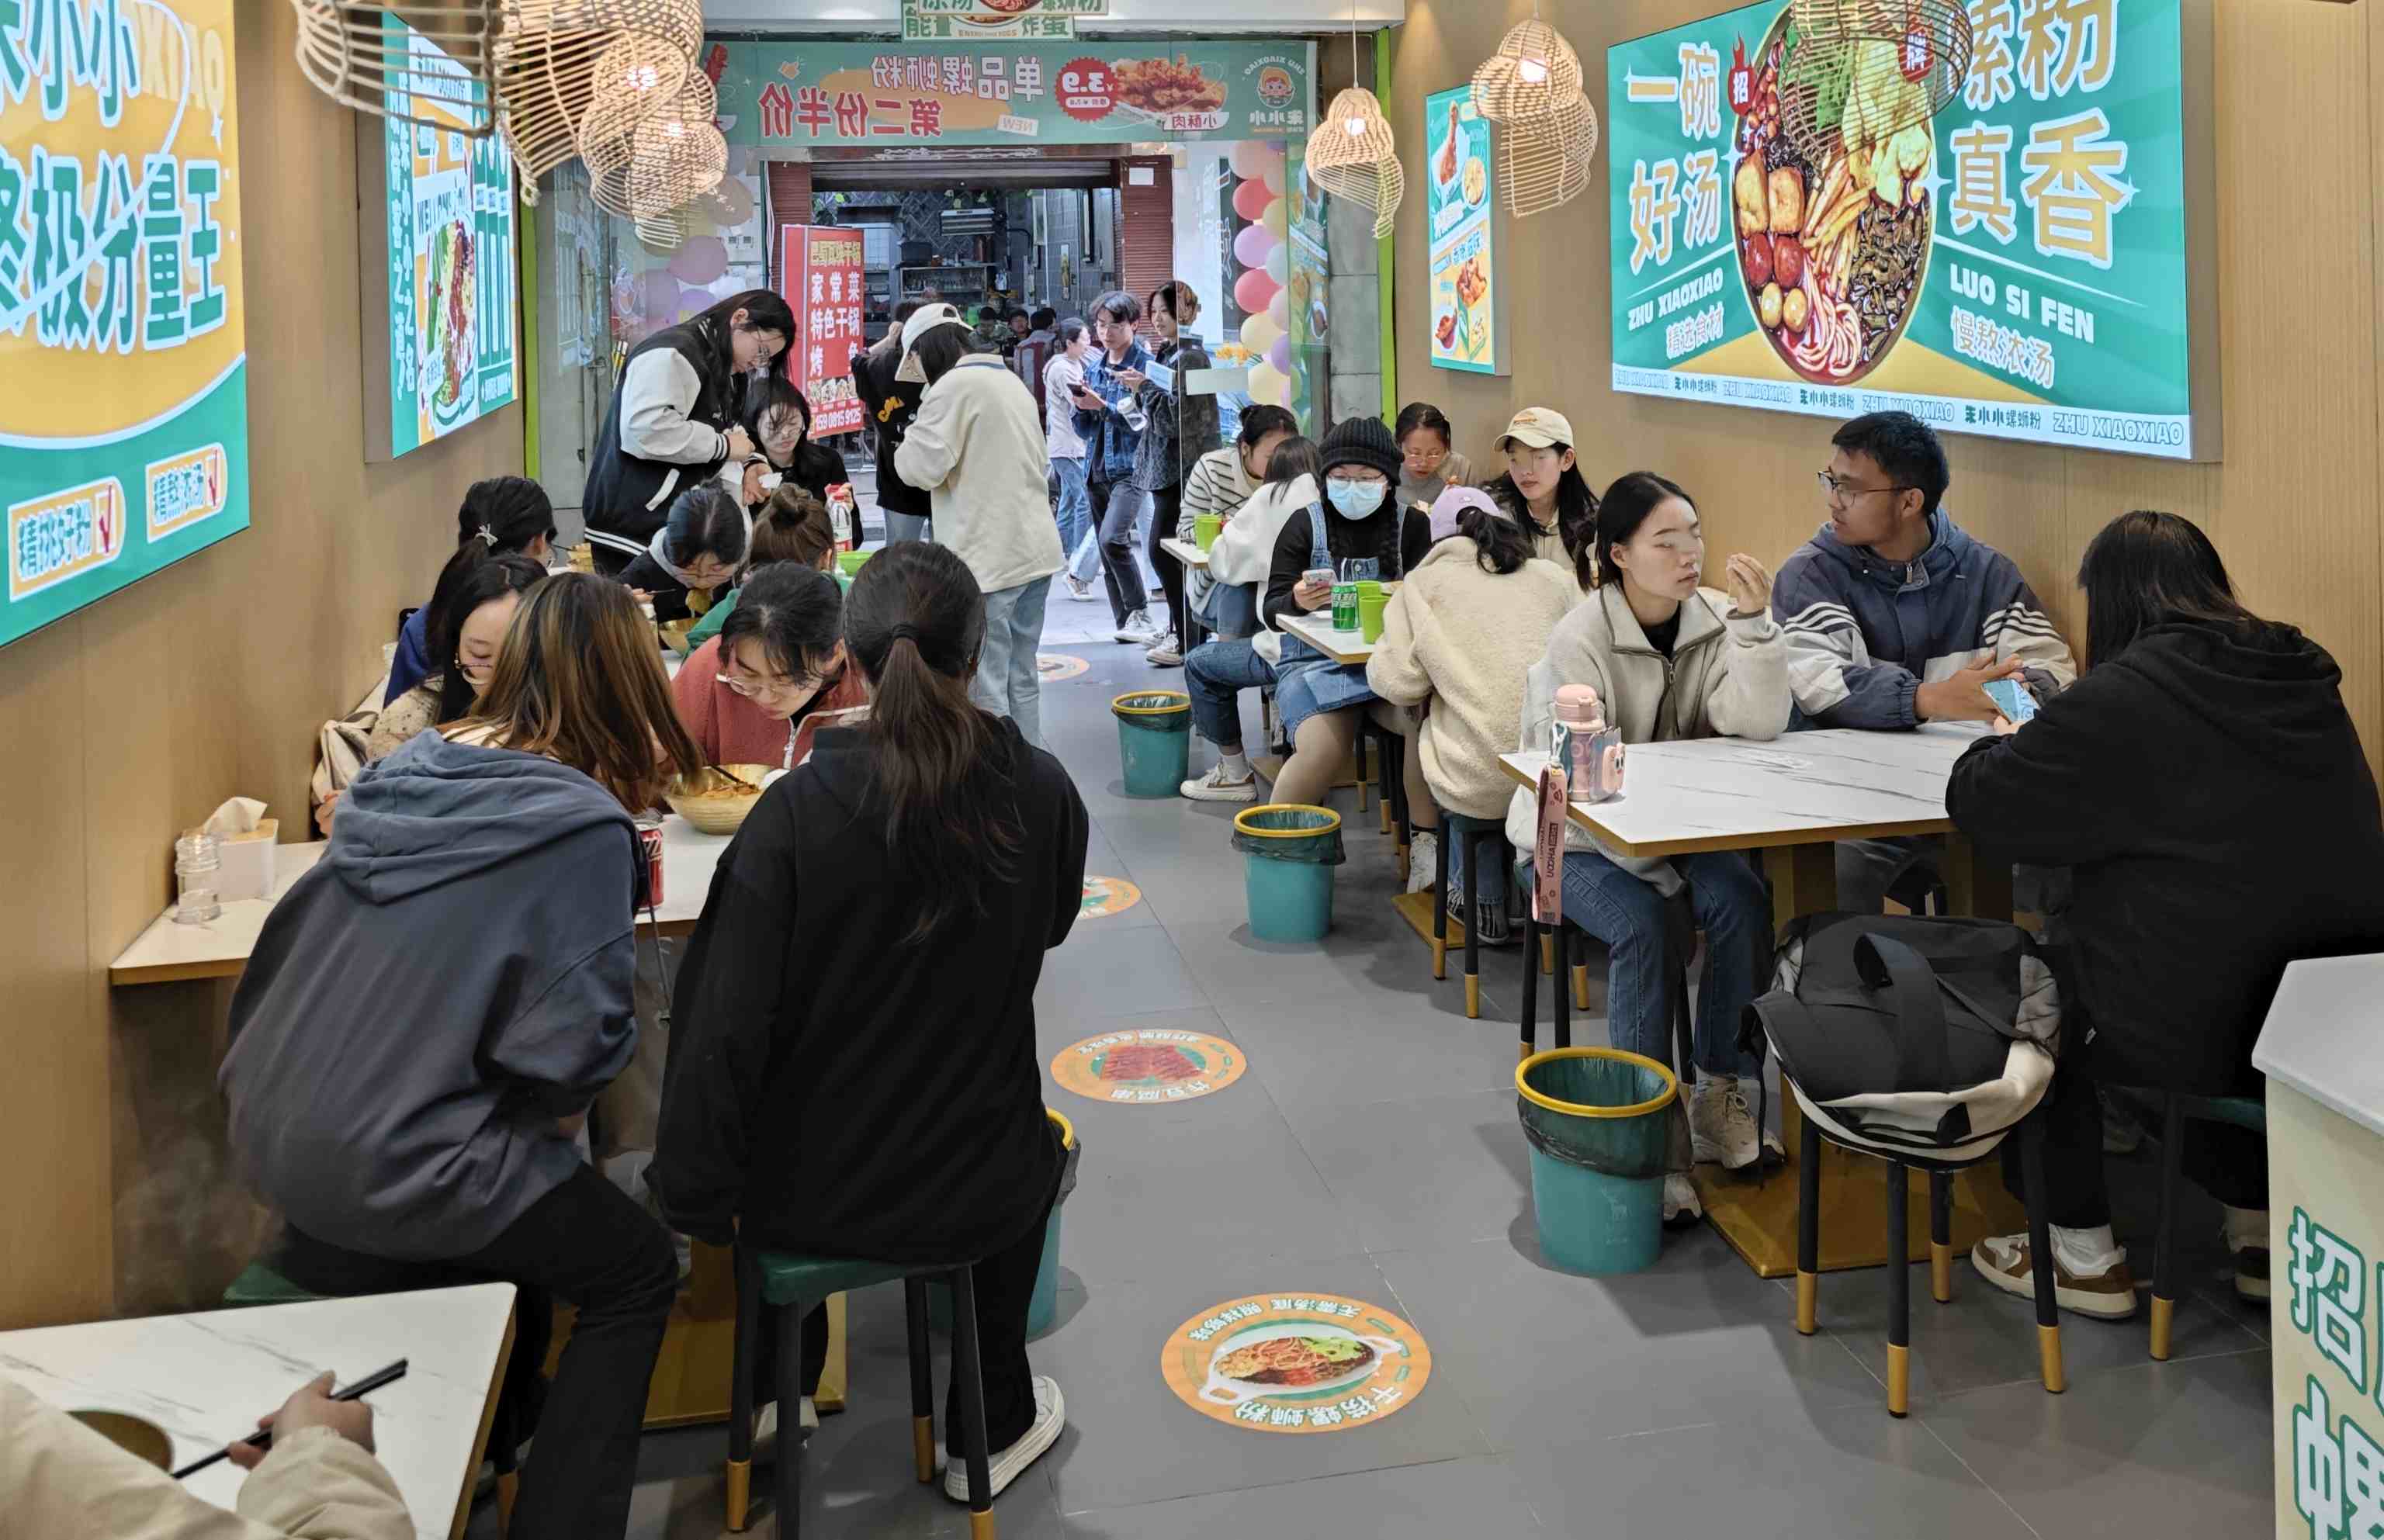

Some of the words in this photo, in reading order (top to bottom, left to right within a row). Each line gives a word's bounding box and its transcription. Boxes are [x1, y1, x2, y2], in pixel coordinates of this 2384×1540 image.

[1627, 41, 1720, 141] 一碗
[1733, 71, 1749, 105] 招
[1630, 148, 1721, 276] 好汤
[1949, 107, 2126, 270] 真香
[810, 272, 861, 304] 家常菜
[1627, 300, 1654, 331] ZHU
[1657, 267, 1724, 318] XIAOXIAO
[1949, 262, 1996, 306] LUO
[2005, 284, 2030, 320] SI
[2040, 296, 2094, 344] FEN
[810, 307, 861, 342] 特色干锅
[1665, 301, 1724, 360] 精选食材
[1950, 304, 2055, 389] 慢熬浓汤
[1964, 404, 2042, 431] 朱小小螺蛳粉
[2053, 412, 2089, 435] ZHU
[2091, 417, 2184, 446] XIAOXIAO
[1234, 1385, 1404, 1428] 干捞螺蛳粉
